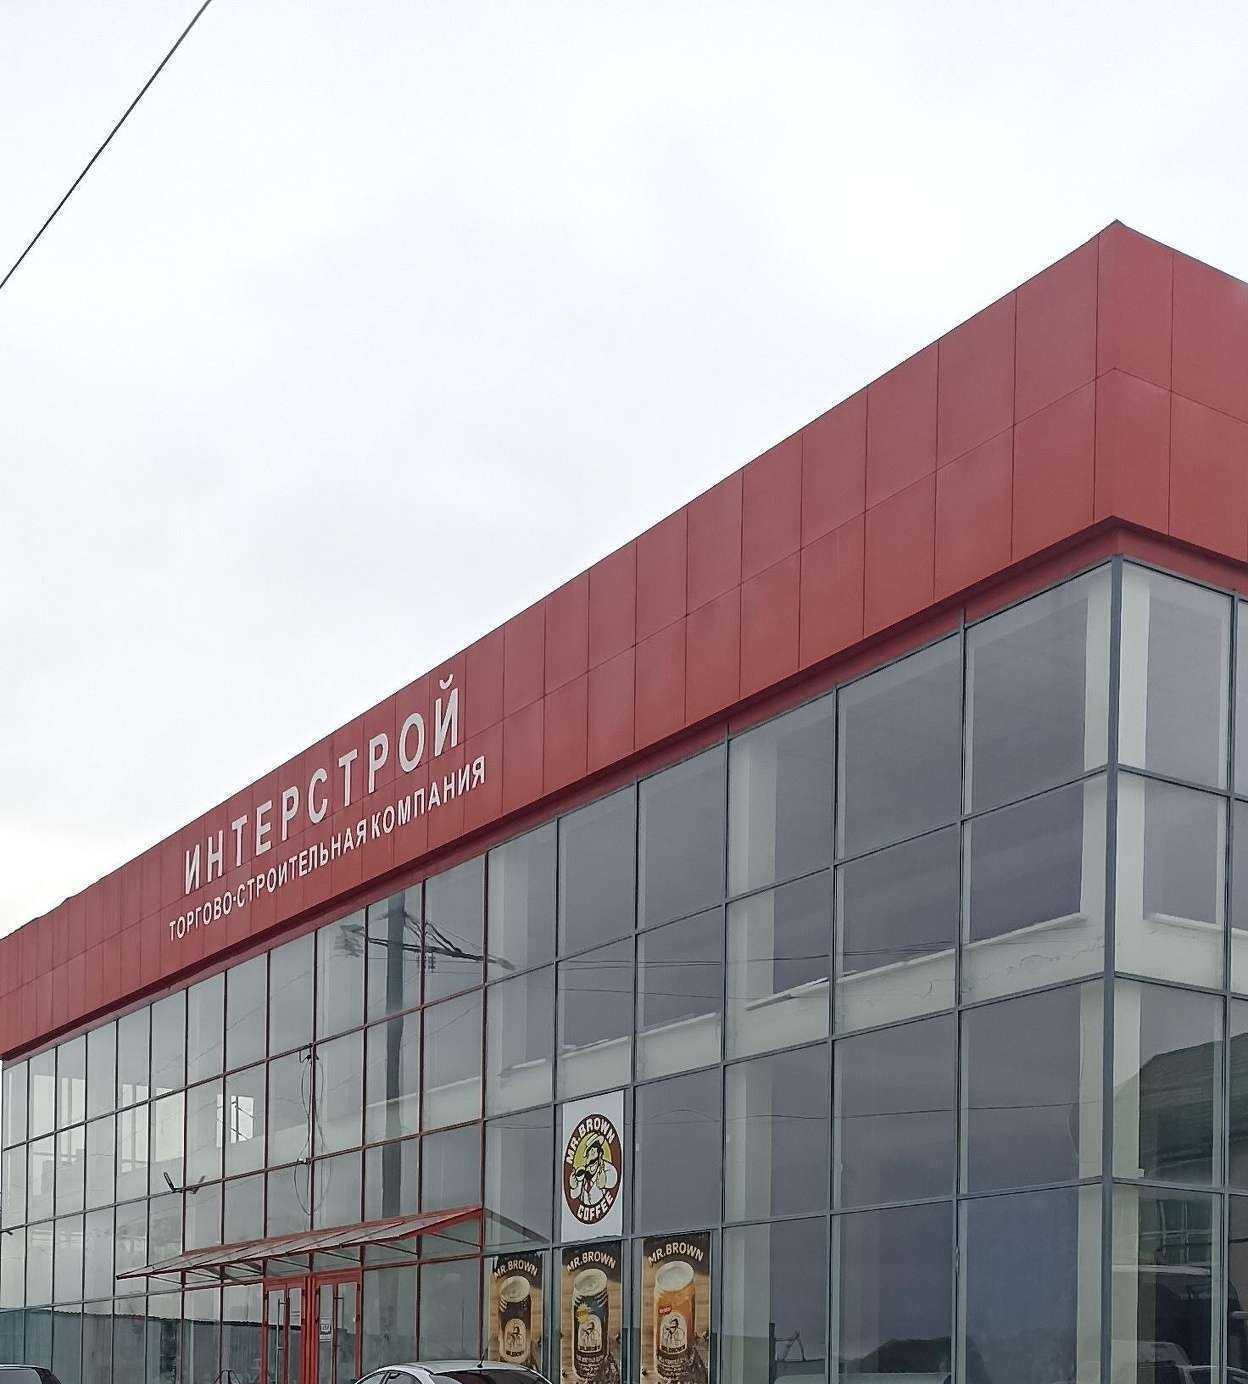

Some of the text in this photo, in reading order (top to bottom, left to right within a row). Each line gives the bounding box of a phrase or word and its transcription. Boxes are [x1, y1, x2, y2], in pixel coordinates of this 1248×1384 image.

[169, 755, 487, 942] ТОРГОВО-СТРОИТЕЛЬНАЯ КОМПАНИЯ
[184, 674, 459, 895] ИНТЕРСТРОЙ
[577, 1190, 614, 1221] COFFEE
